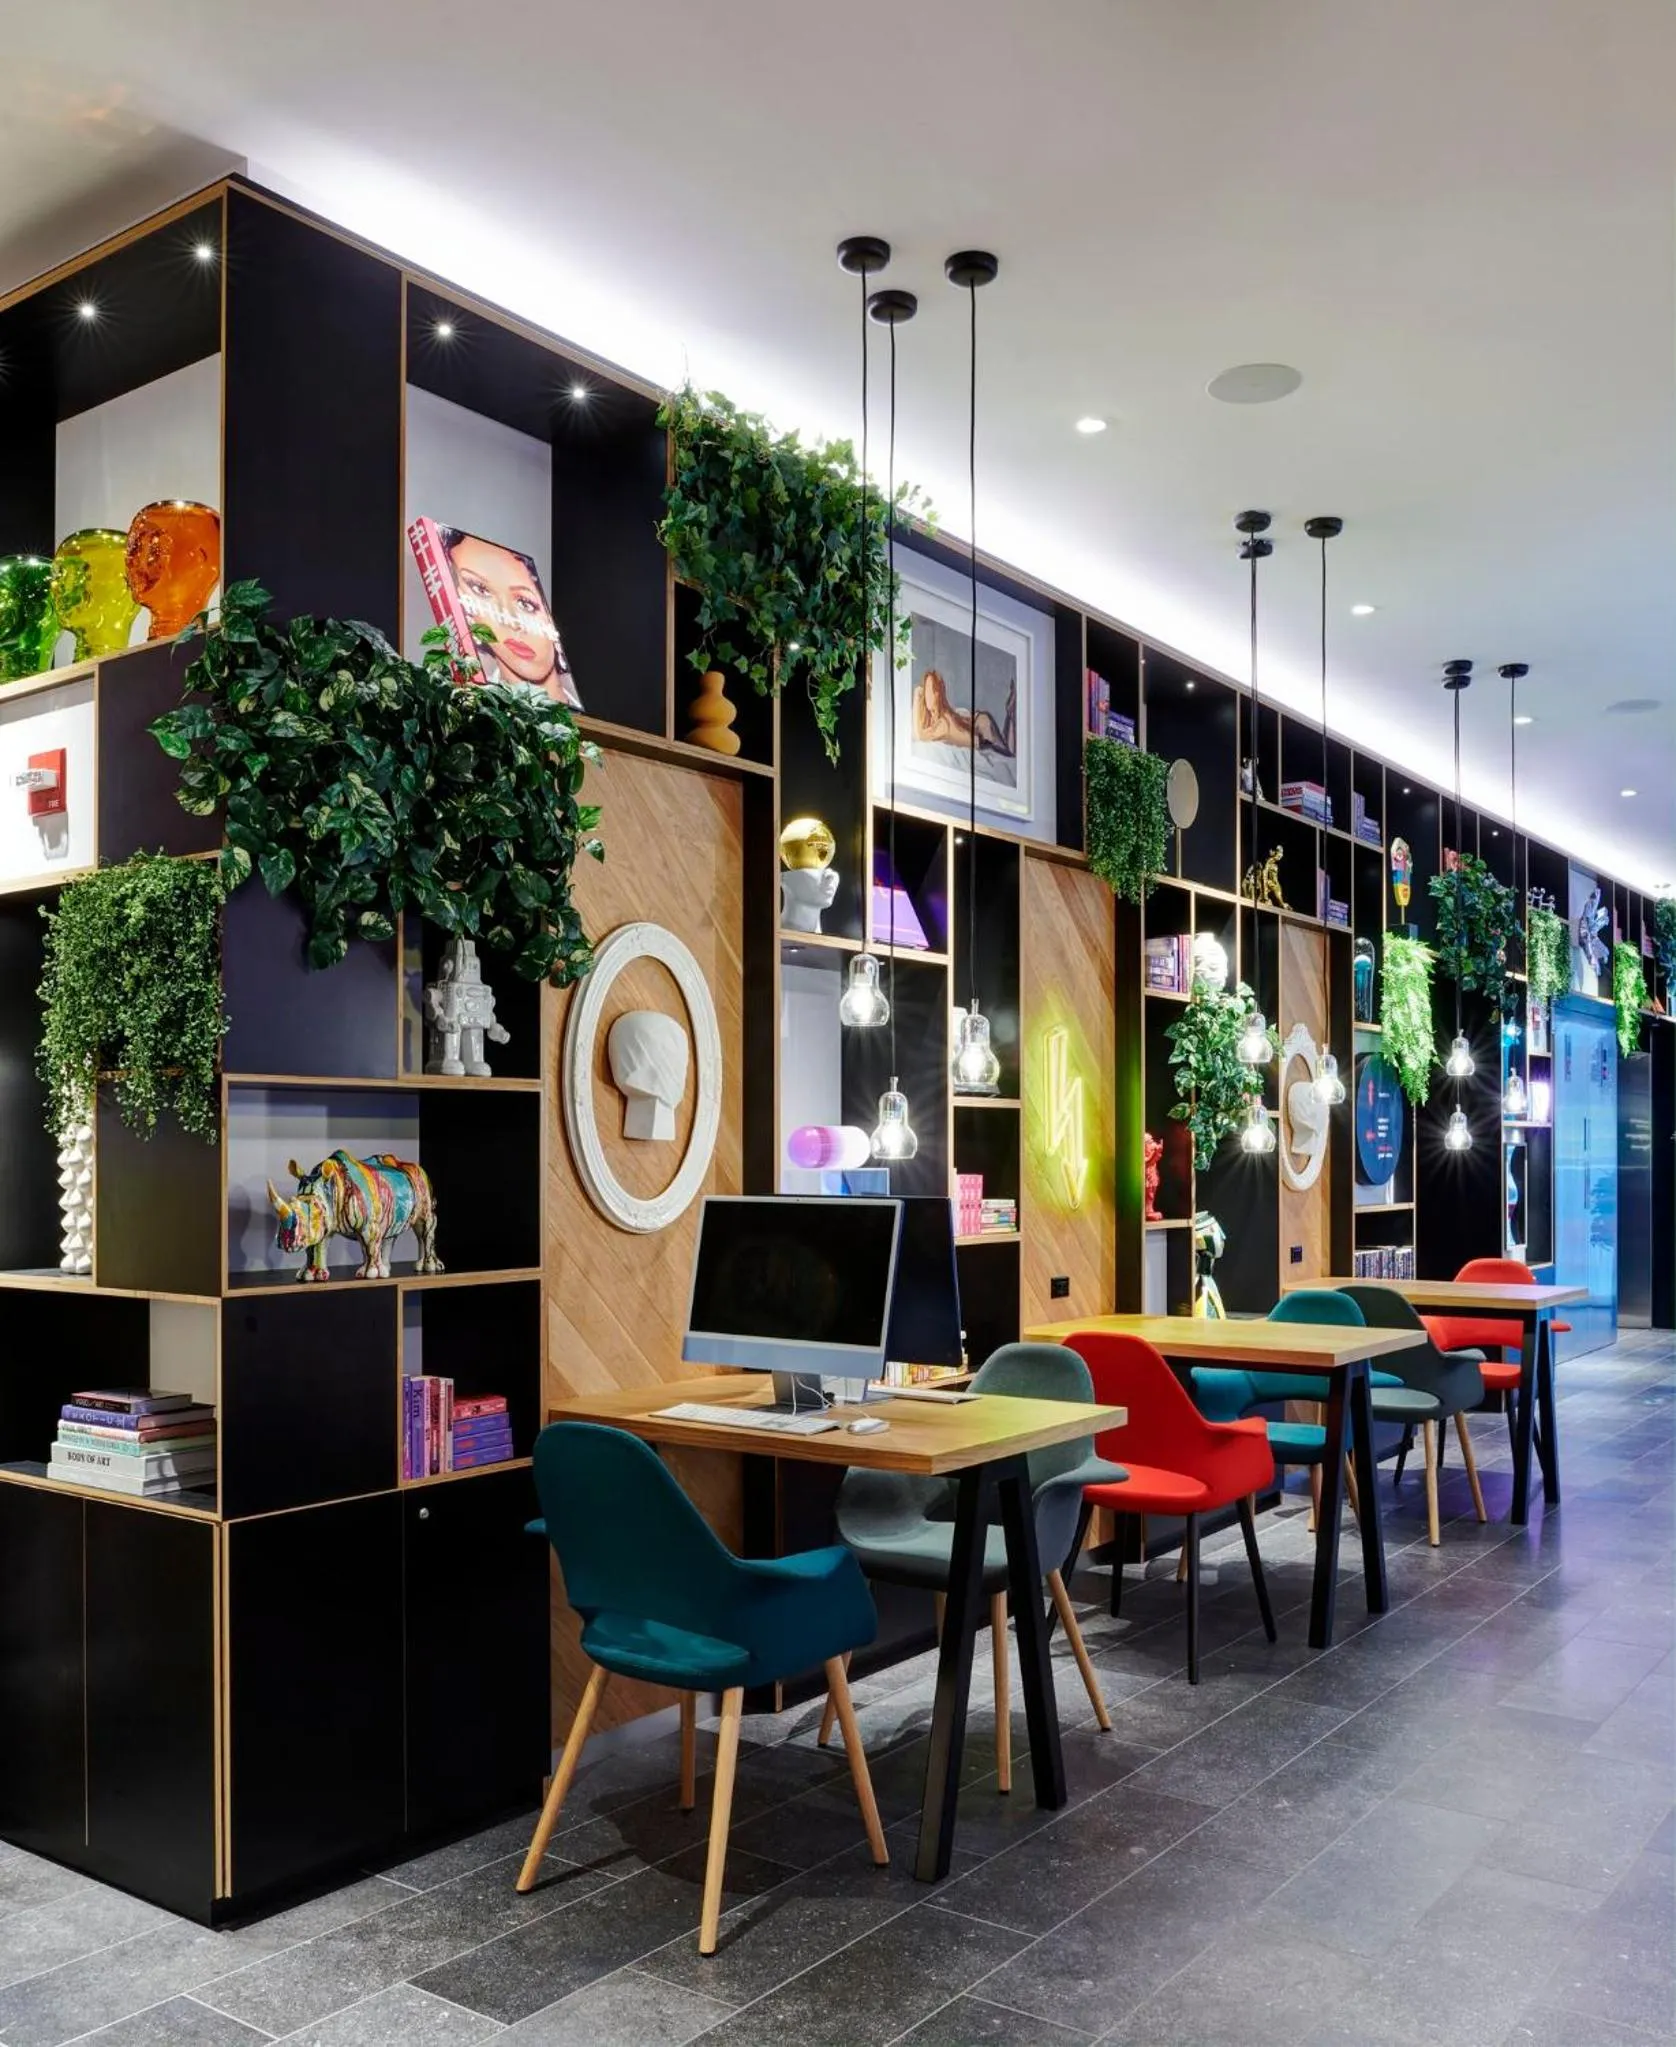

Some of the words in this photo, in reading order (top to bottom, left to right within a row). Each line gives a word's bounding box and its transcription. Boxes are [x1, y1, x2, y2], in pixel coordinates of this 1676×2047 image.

[67, 1451, 85, 1463] BODY
[86, 1454, 95, 1464] OF
[96, 1456, 110, 1466] ART
